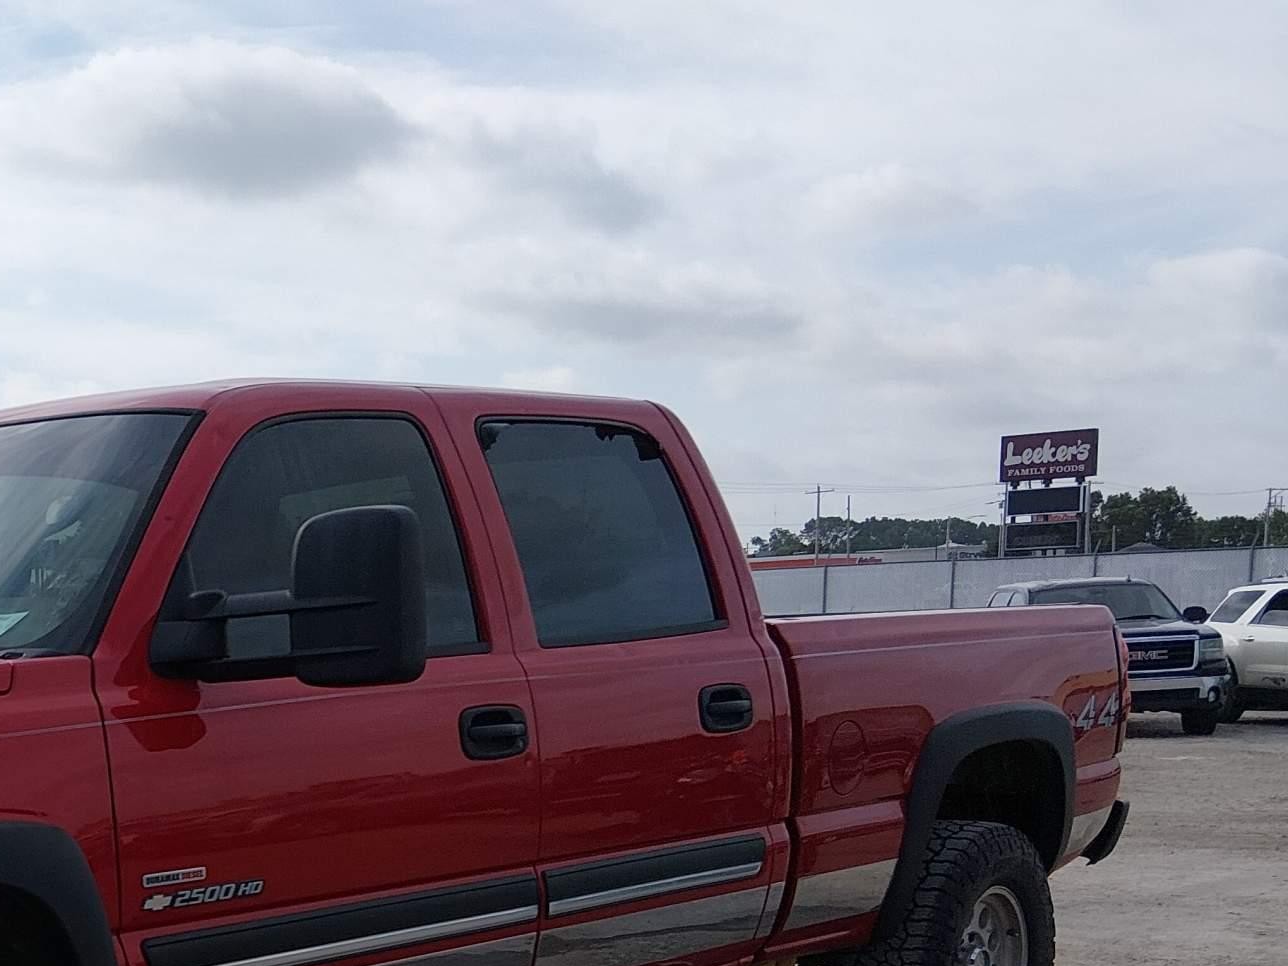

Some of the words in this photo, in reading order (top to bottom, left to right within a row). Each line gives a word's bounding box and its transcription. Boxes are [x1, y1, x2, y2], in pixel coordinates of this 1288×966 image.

[1003, 438, 1091, 466] Leeker's
[1007, 466, 1047, 477] FAMILY
[1049, 464, 1085, 474] FOODS
[173, 883, 236, 907] 2500
[237, 880, 264, 896] HD
